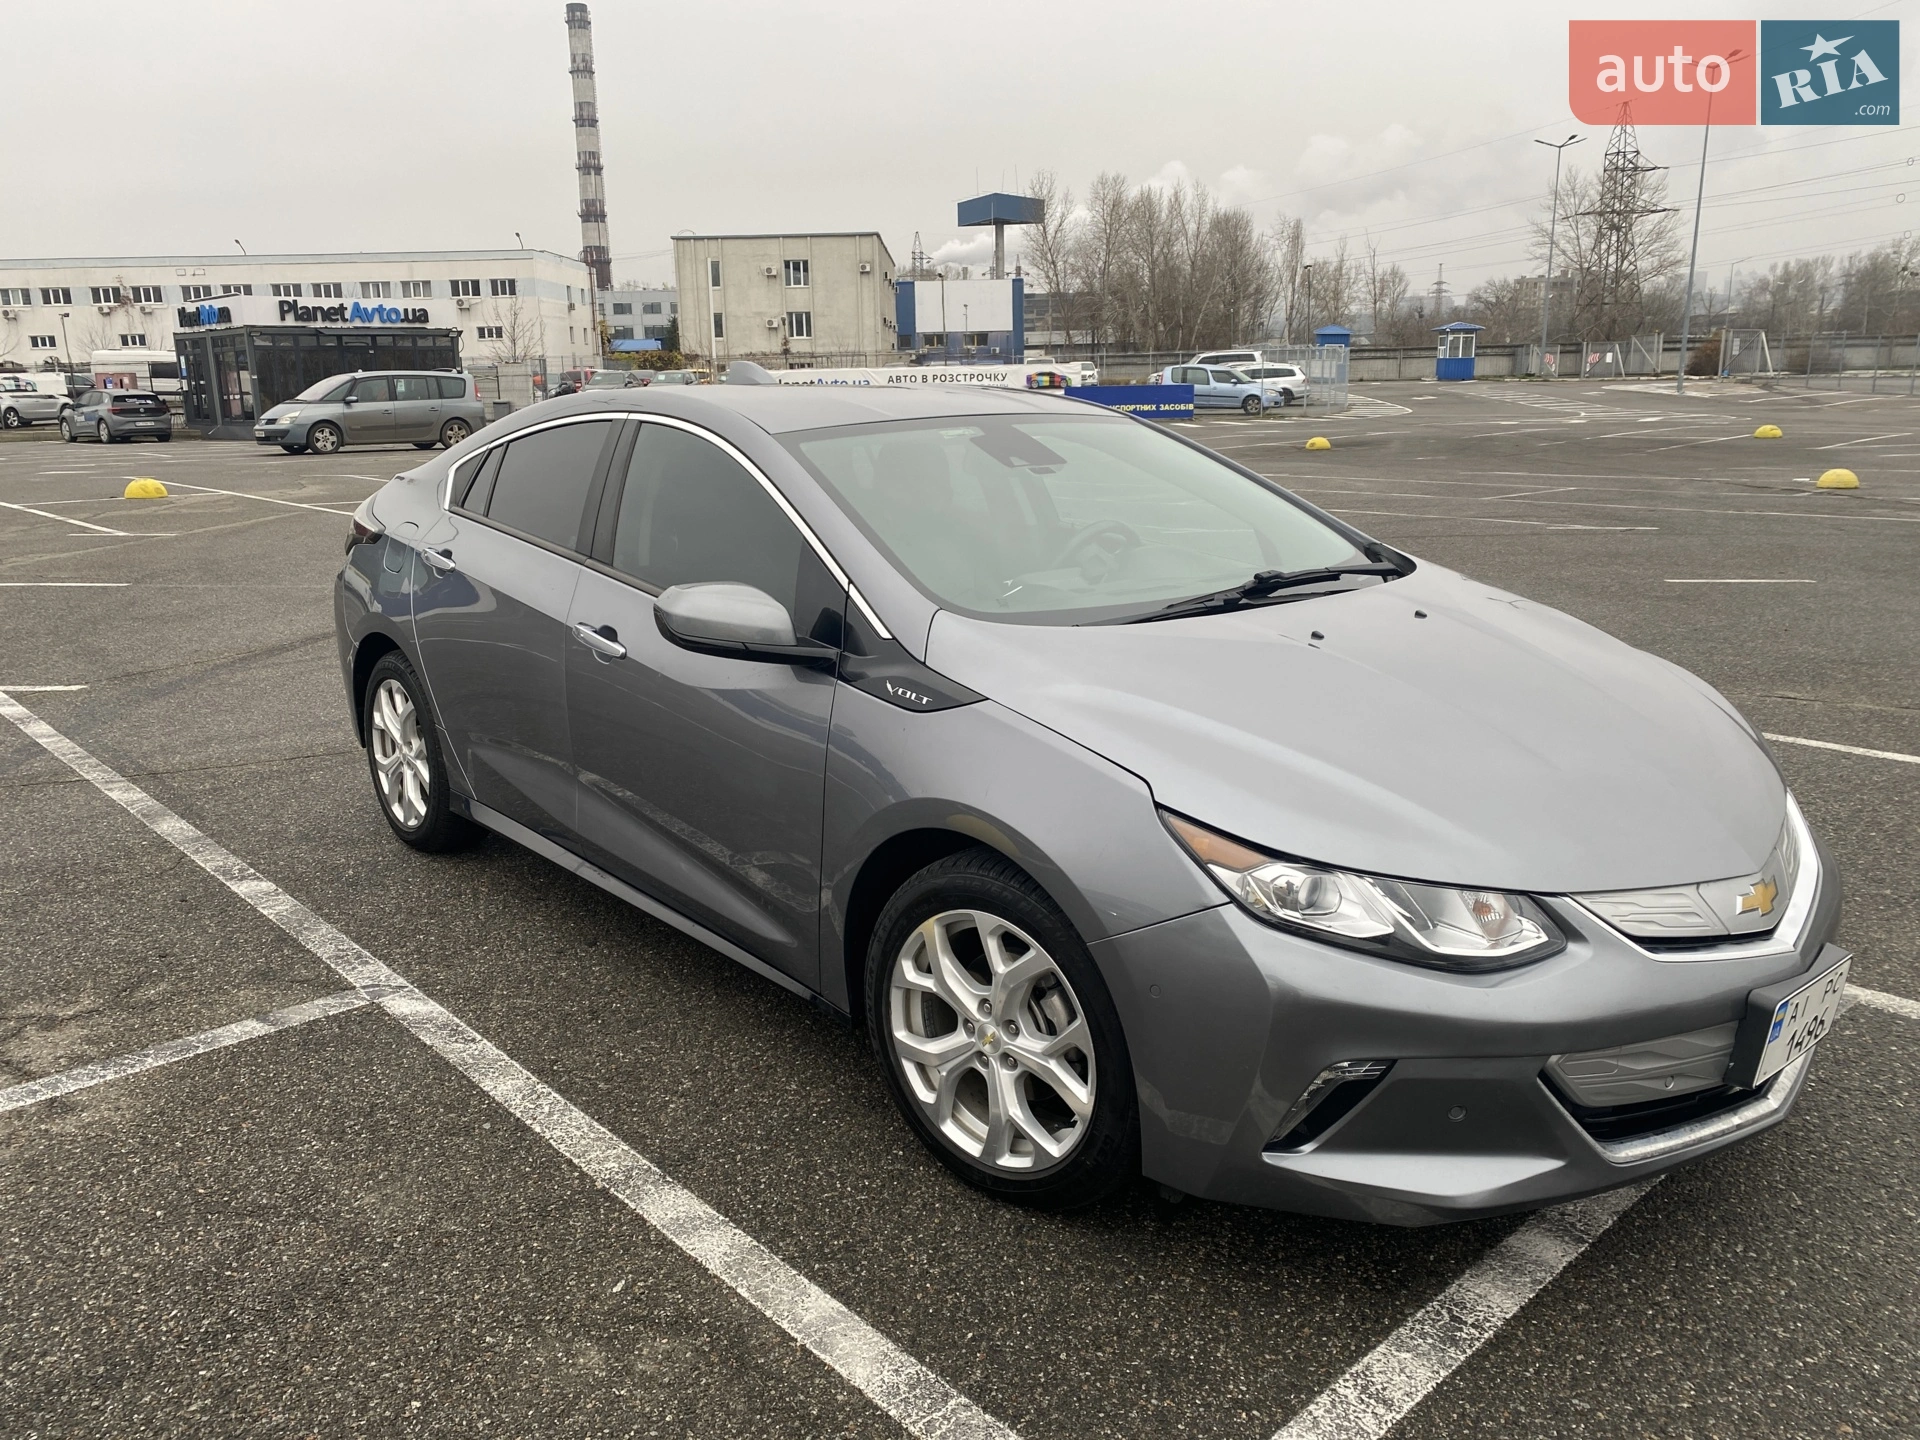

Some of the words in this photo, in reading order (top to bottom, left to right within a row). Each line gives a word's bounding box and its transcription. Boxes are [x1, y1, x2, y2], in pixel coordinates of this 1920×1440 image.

[278, 300, 430, 323] PlanetAvto.ua
[887, 374, 917, 384] АВТО
[921, 374, 928, 383] В
[932, 372, 1008, 383] РОЗСТРОЧКУ
[1159, 403, 1194, 411] ЗАСОБІВ
[886, 679, 933, 705] VOLT
[1787, 994, 1809, 1027] AI
[1821, 971, 1843, 1003] PC
[1786, 1007, 1829, 1062] 1496
